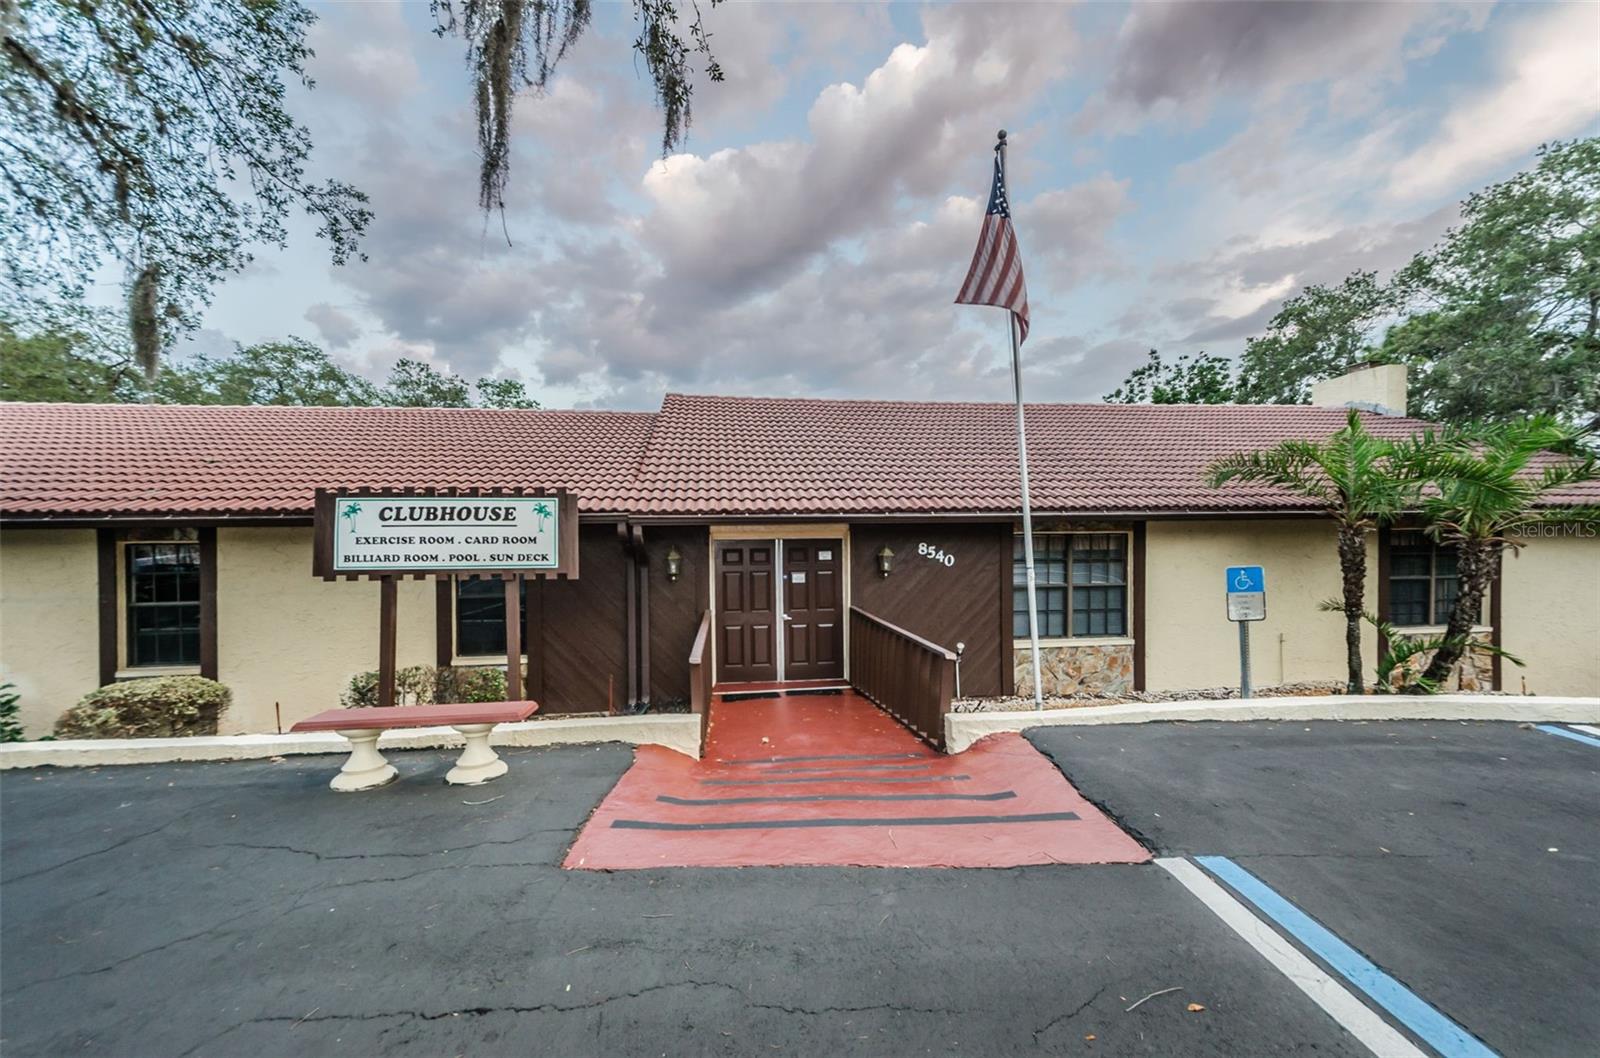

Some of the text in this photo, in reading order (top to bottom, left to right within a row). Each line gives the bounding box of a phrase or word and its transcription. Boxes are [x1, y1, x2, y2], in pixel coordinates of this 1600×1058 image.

[379, 506, 517, 522] CLUBHOUSE
[355, 536, 416, 545] EXERCISE
[419, 536, 455, 545] ROOM
[464, 536, 499, 545] CARD
[502, 536, 537, 545] ROOM
[343, 554, 401, 563] BILLIARD
[403, 554, 439, 562] ROOM
[449, 554, 480, 562] POOL
[489, 554, 514, 562] SUN
[517, 554, 550, 562] DECK
[918, 542, 955, 567] 8540
